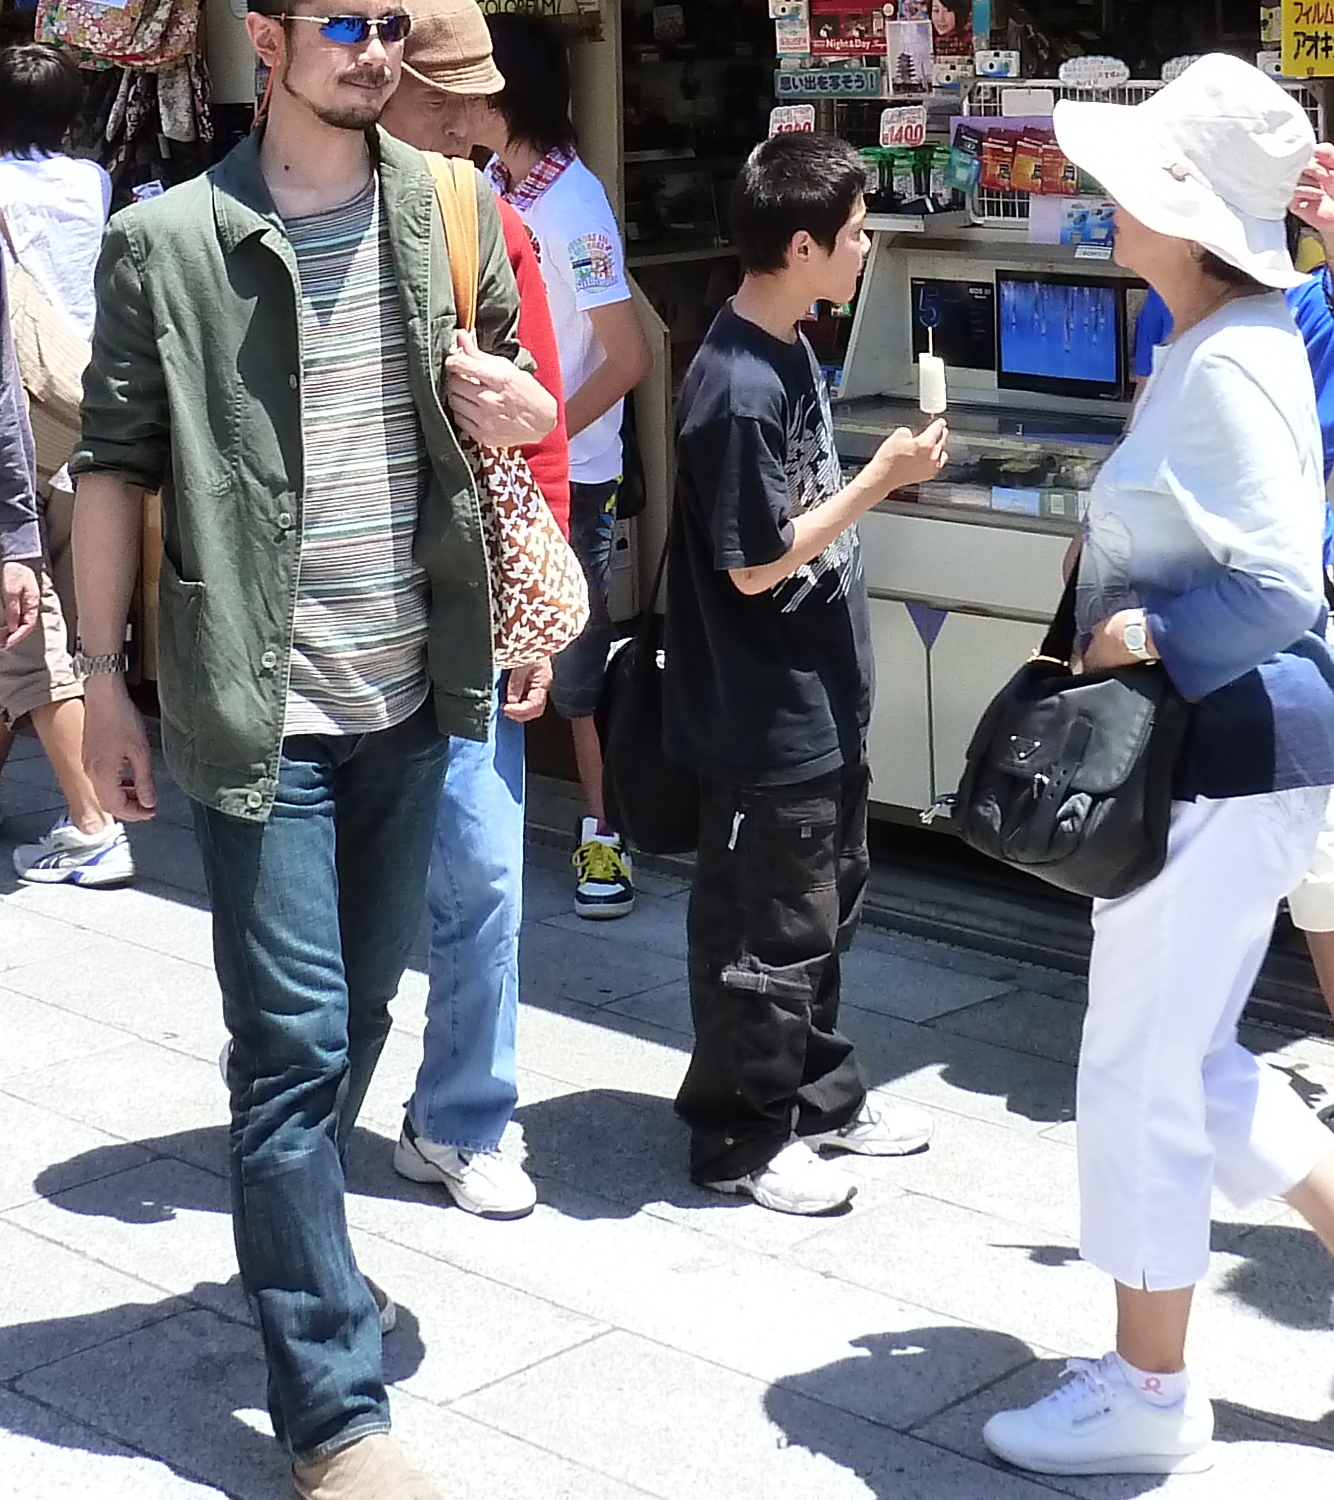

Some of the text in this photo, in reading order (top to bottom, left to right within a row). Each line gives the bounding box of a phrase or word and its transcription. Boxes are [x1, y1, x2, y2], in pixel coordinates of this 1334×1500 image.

[779, 73, 875, 92] 思い出を写そう！
